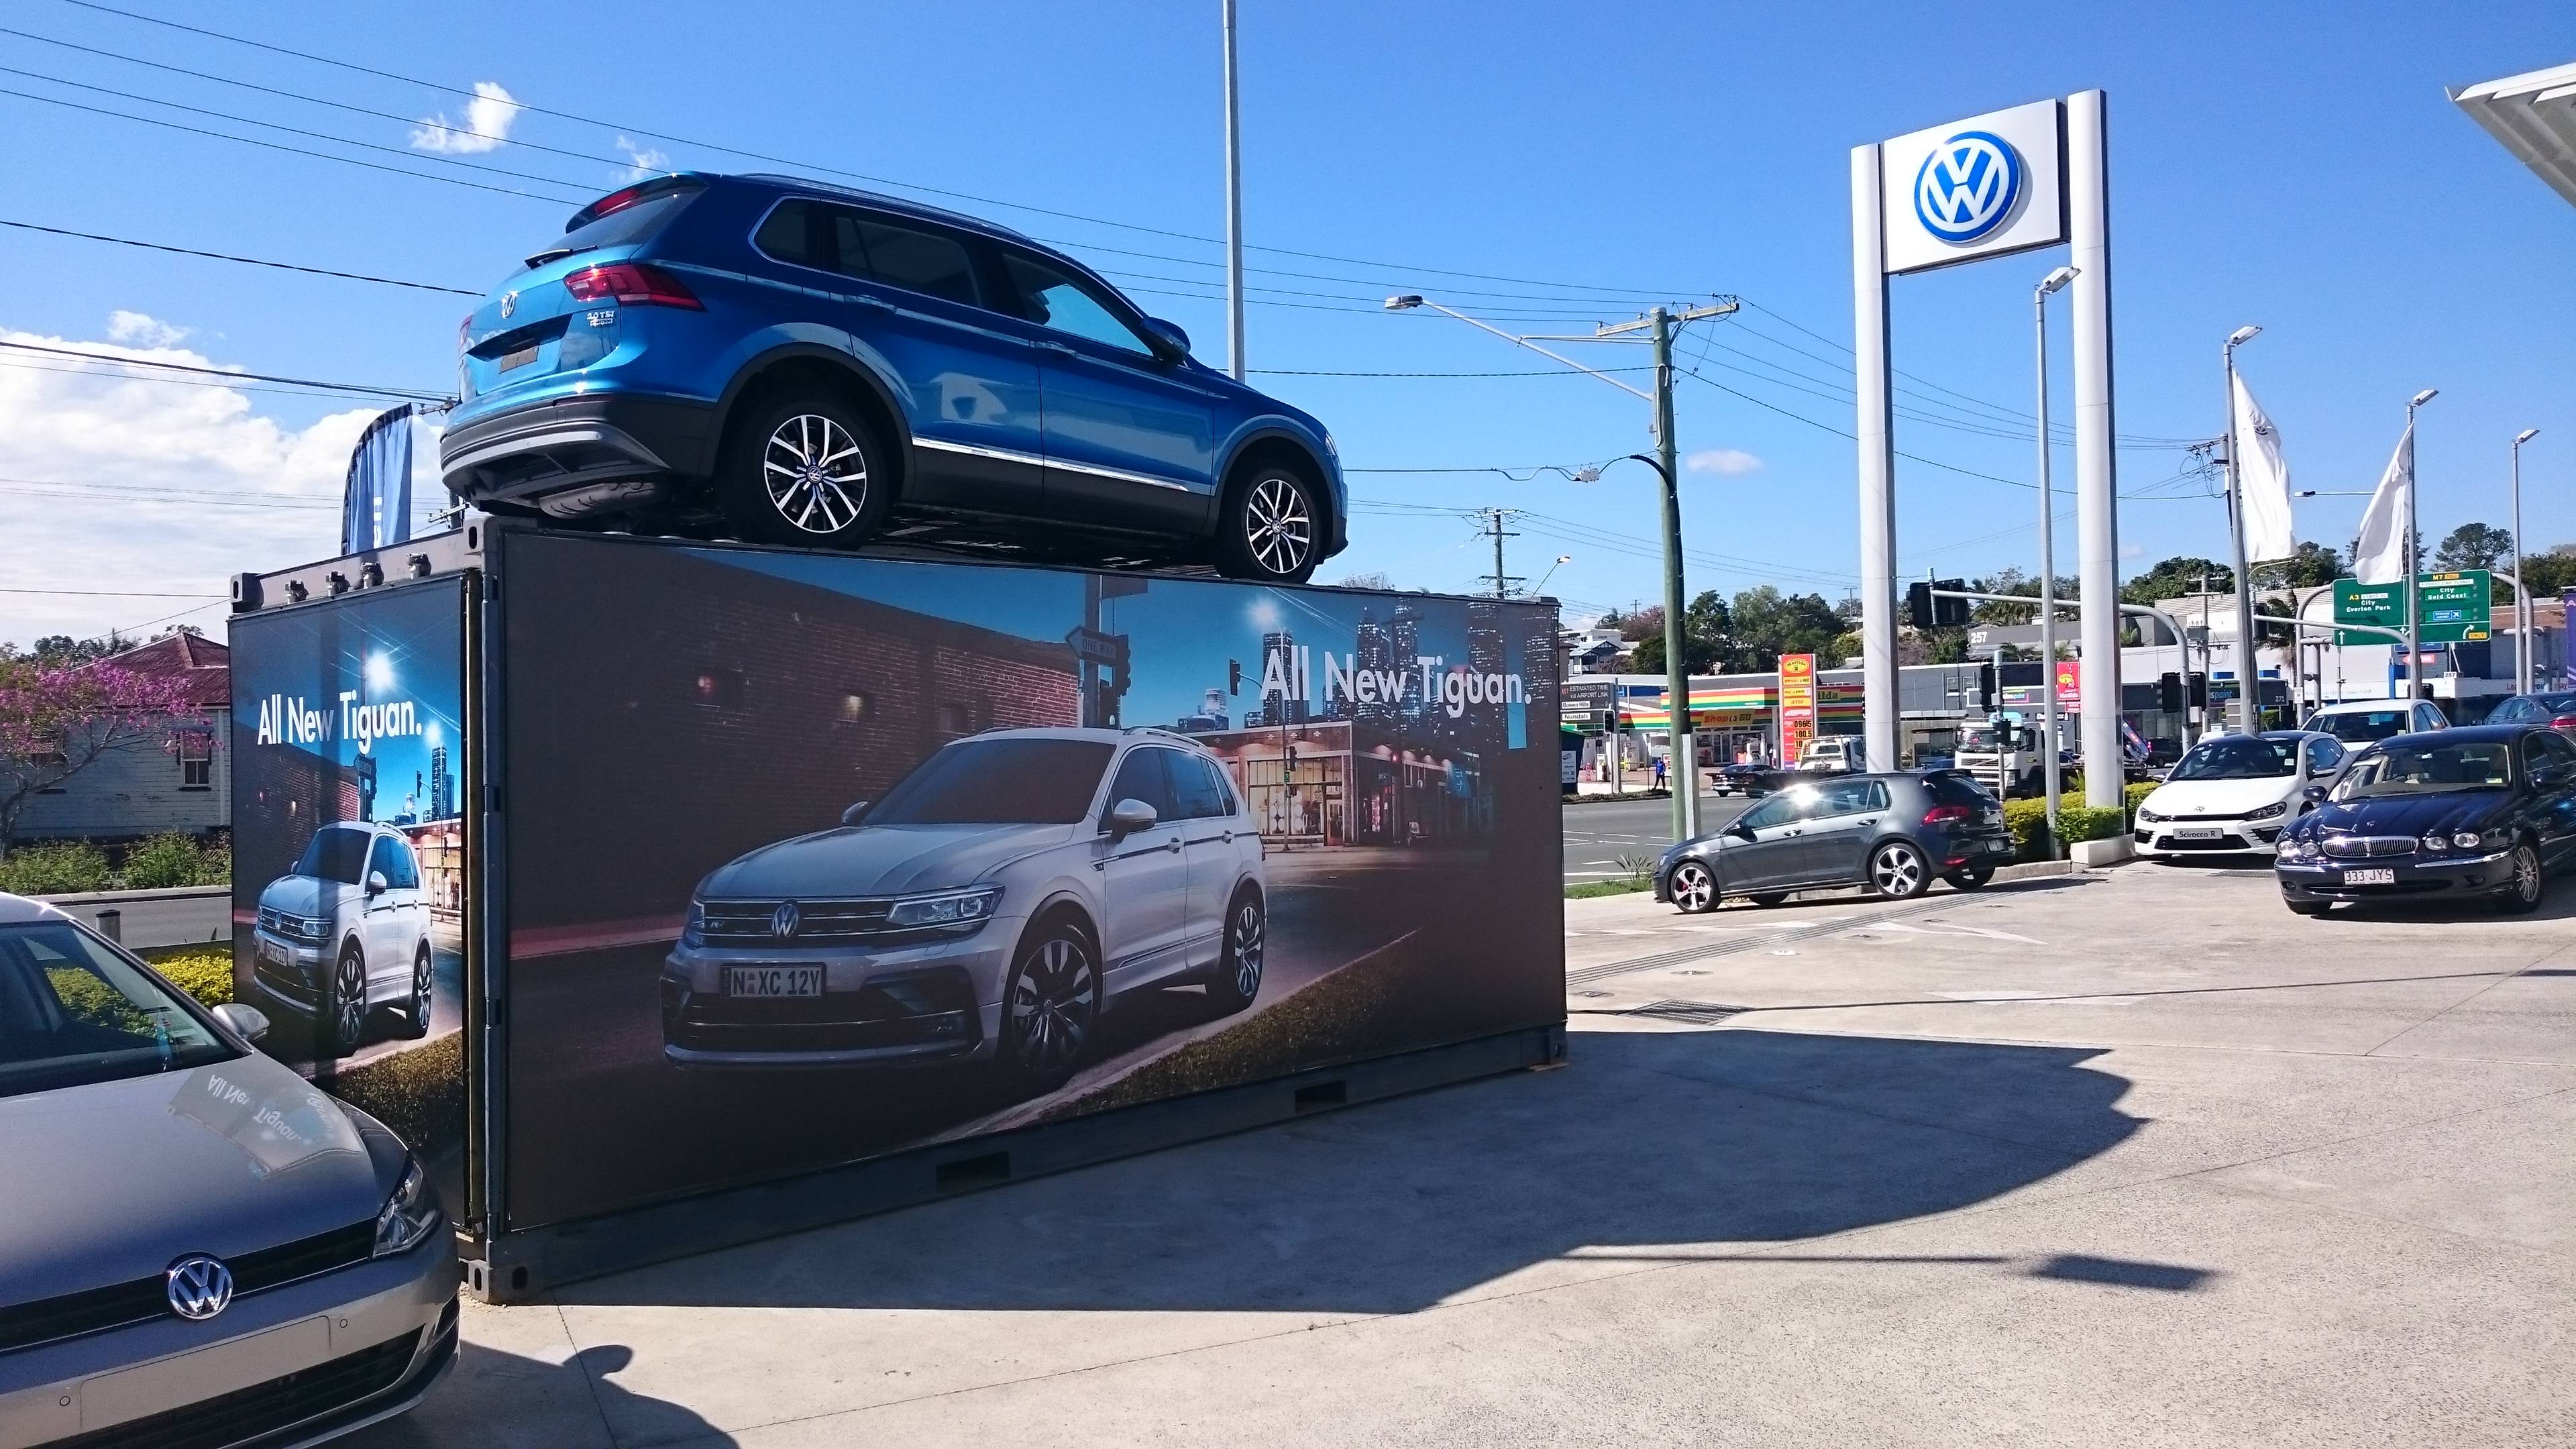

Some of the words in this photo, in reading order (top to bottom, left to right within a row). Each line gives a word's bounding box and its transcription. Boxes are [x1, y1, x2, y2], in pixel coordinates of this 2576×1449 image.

[1970, 631, 1988, 644] 257
[1260, 645, 1310, 702] All
[1324, 651, 1407, 704] New
[1417, 655, 1532, 718] Tiguan.
[257, 694, 282, 745] All
[288, 696, 335, 743] New
[339, 689, 423, 755] Tiguan.
[1704, 714, 1729, 723] Shop
[1739, 713, 1752, 721] GO
[1795, 730, 1813, 738] 100.5
[788, 971, 820, 995] 12Y
